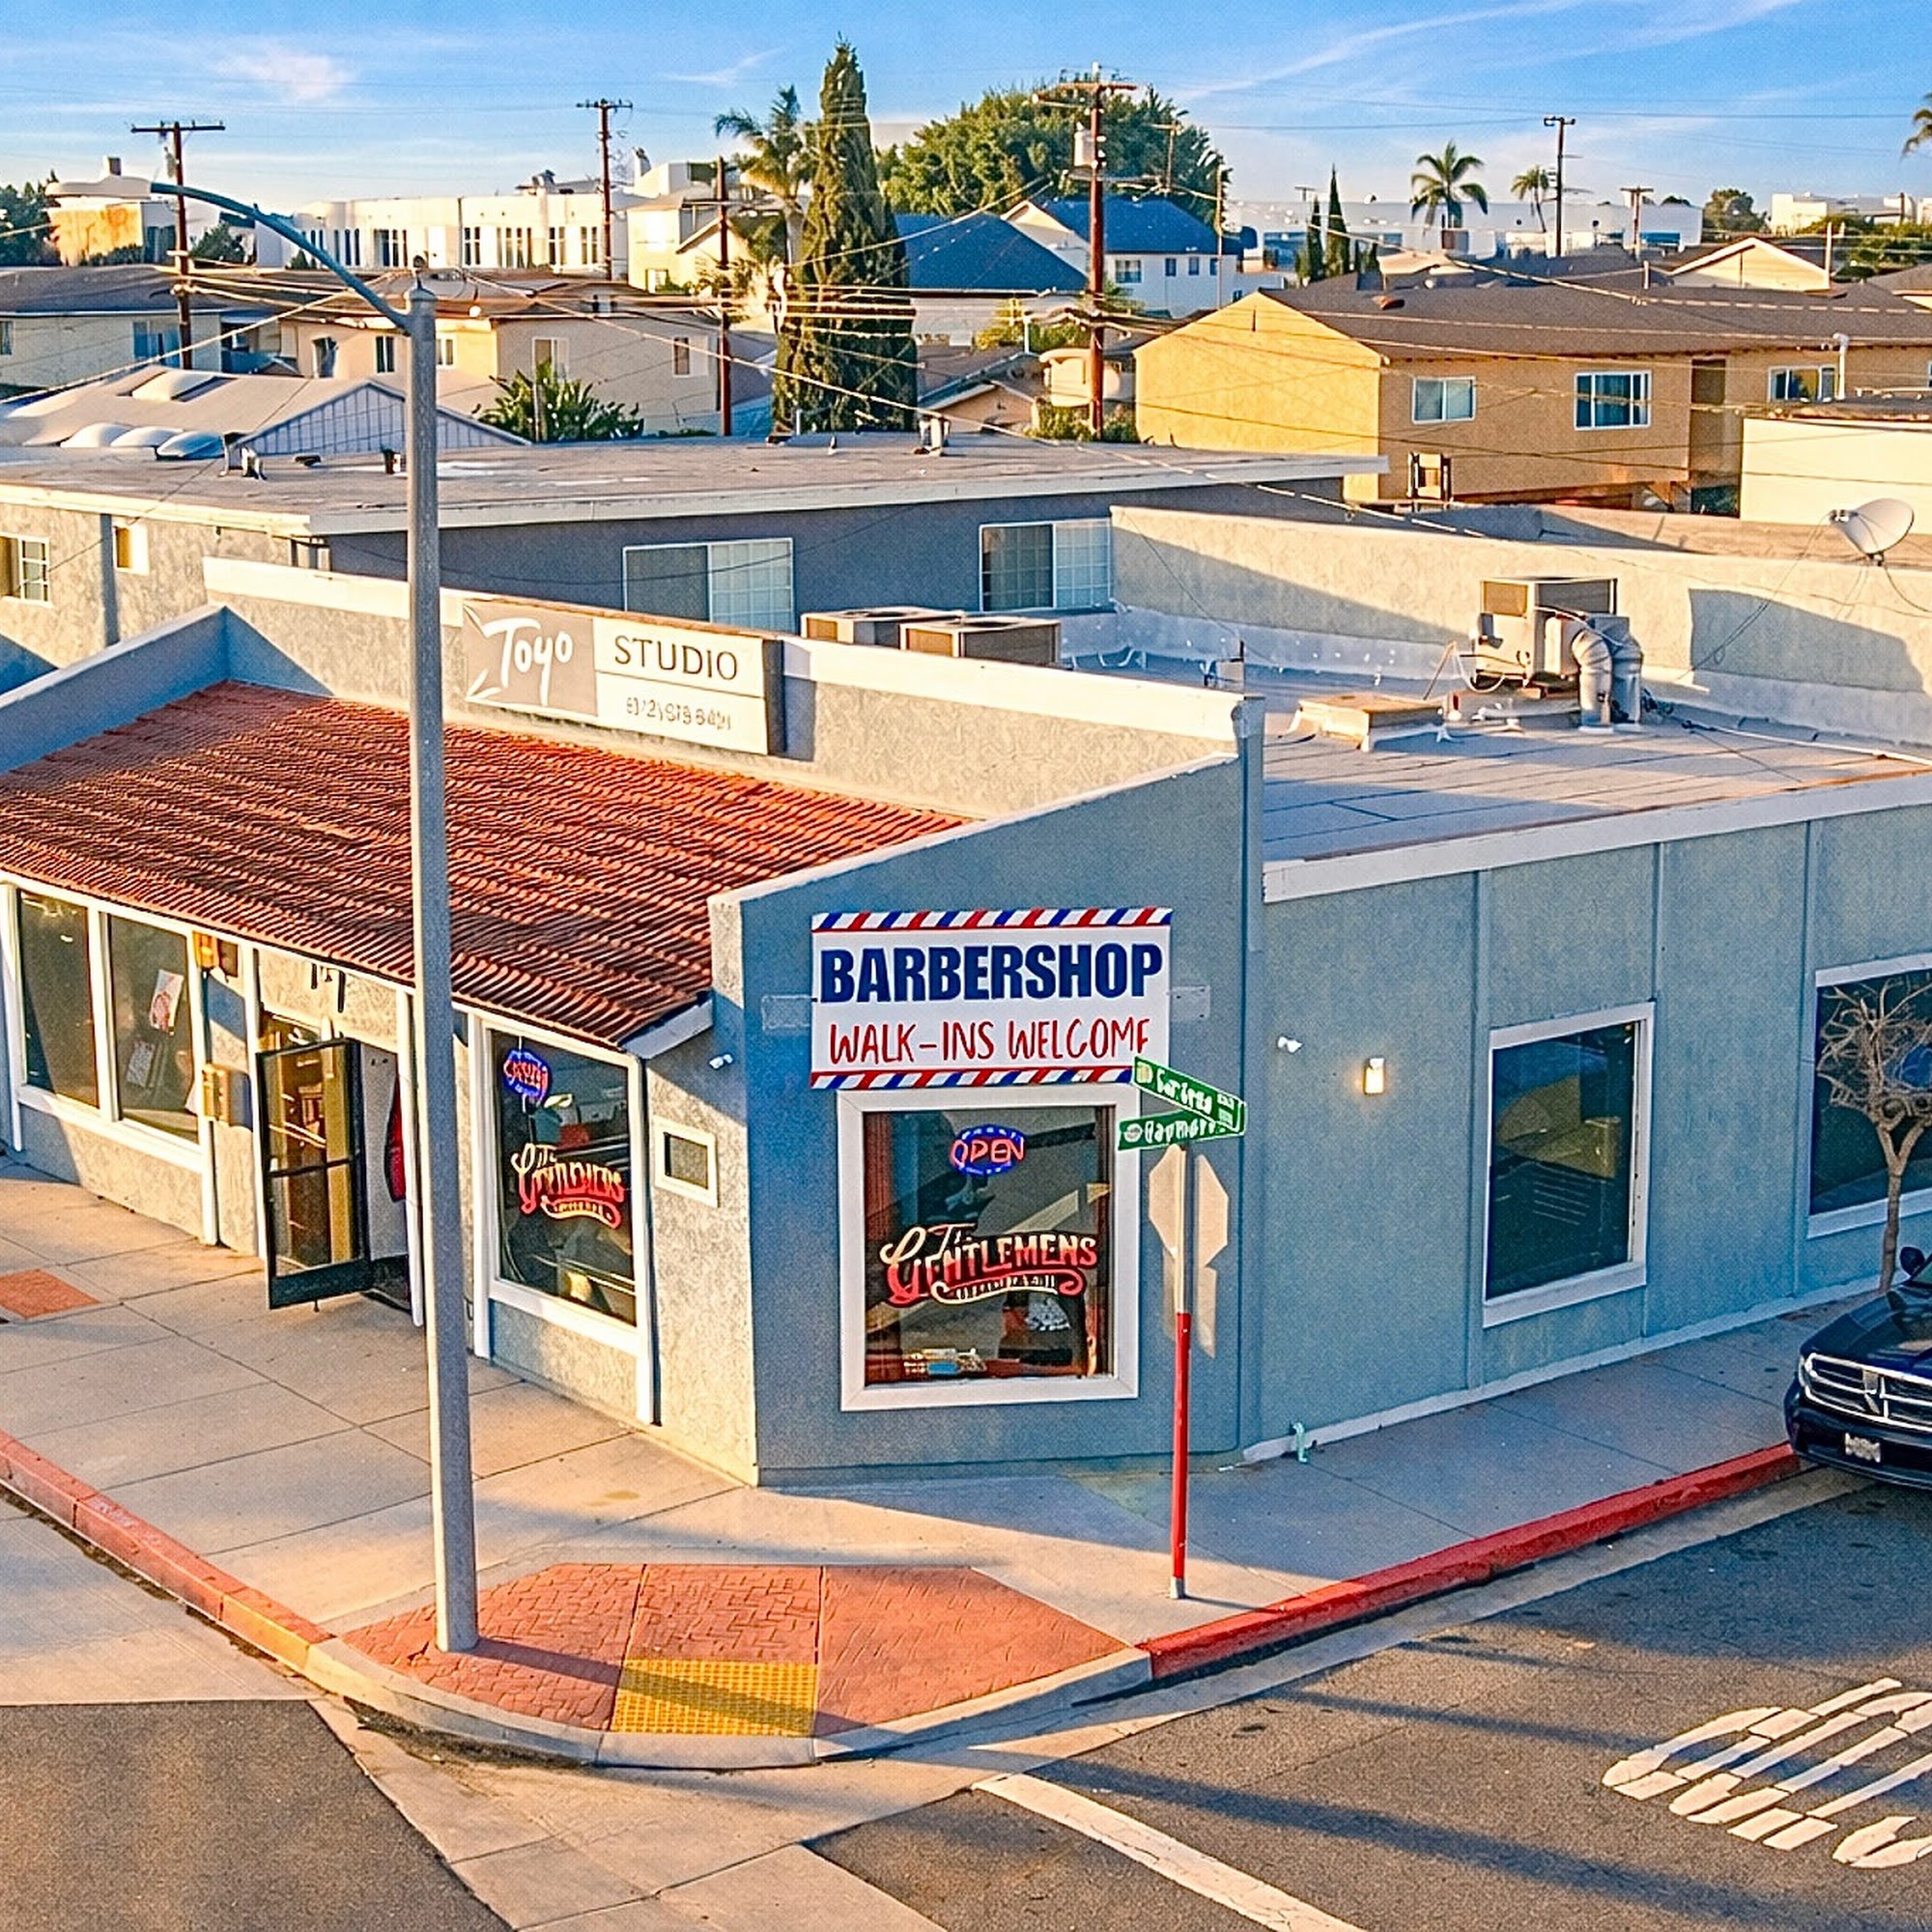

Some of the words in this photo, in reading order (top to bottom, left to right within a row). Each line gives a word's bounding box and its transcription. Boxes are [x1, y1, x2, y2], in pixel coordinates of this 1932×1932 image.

[483, 617, 573, 706] Toyo
[614, 635, 738, 681] STUDIO
[820, 943, 1163, 1003] BARBERSHOP
[830, 1021, 995, 1064] WALK-INS
[1008, 1016, 1151, 1060] WELCOME
[952, 1138, 1026, 1165] OPEN
